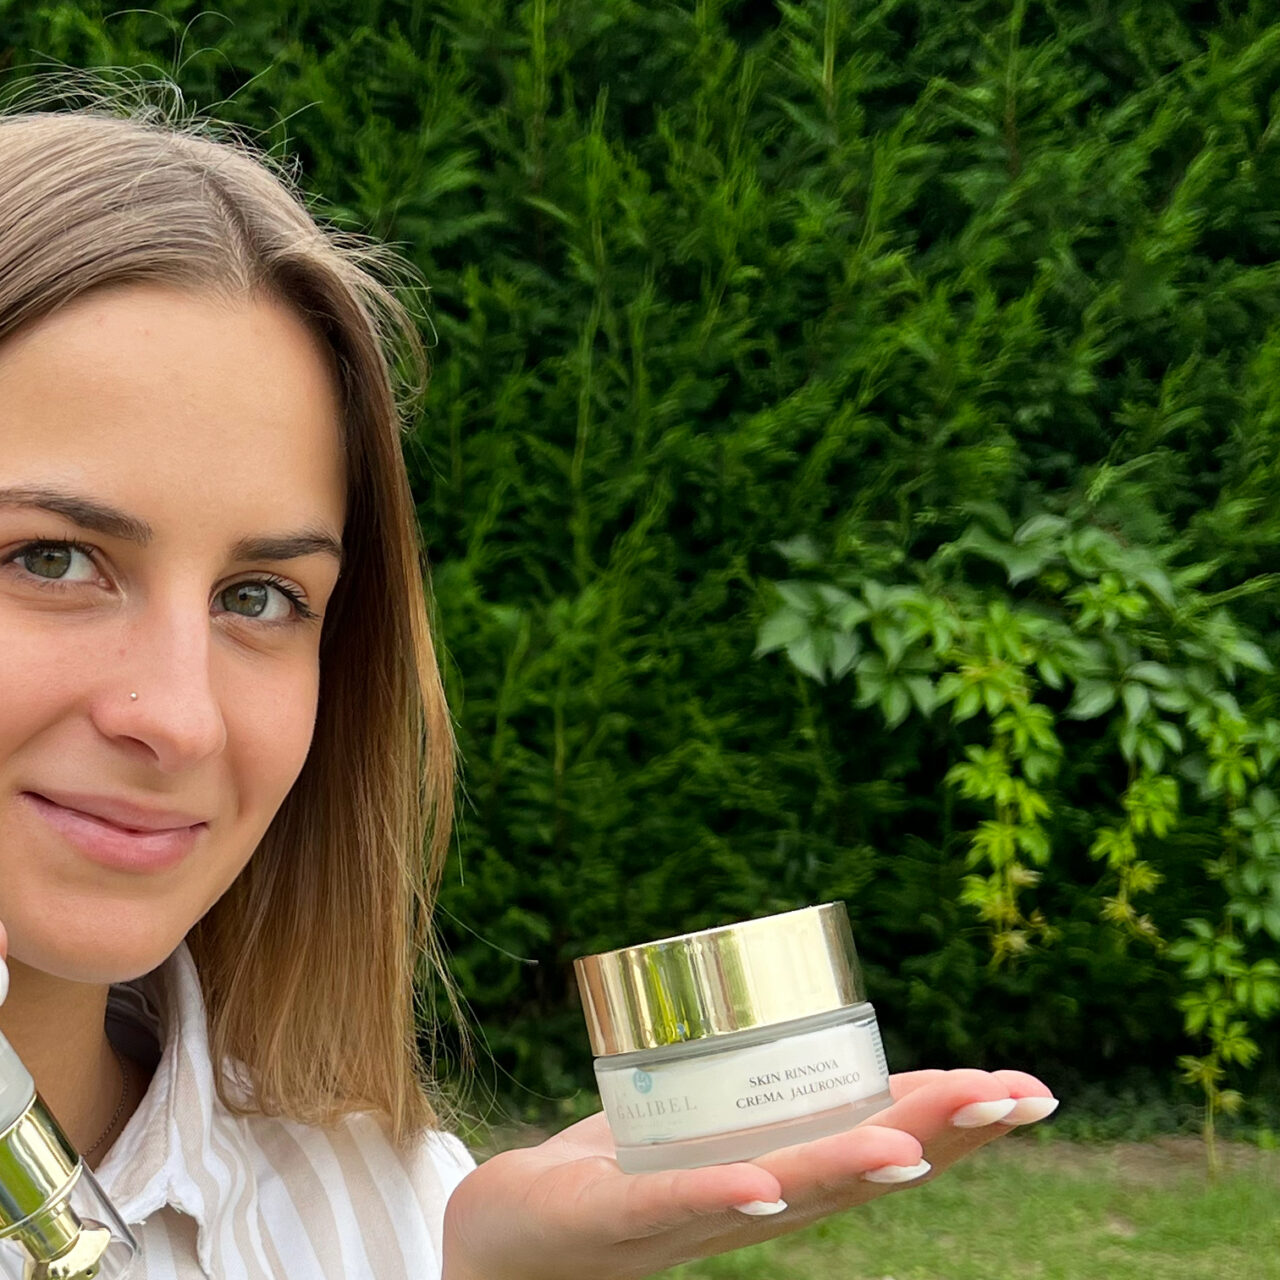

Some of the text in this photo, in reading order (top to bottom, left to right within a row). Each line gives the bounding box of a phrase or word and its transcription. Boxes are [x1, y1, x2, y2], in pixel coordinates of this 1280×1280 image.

[748, 1059, 839, 1088] SKIN RINNOVA
[736, 1071, 860, 1109] CREMA JALURONICO
[616, 1095, 697, 1120] GALIBEL
